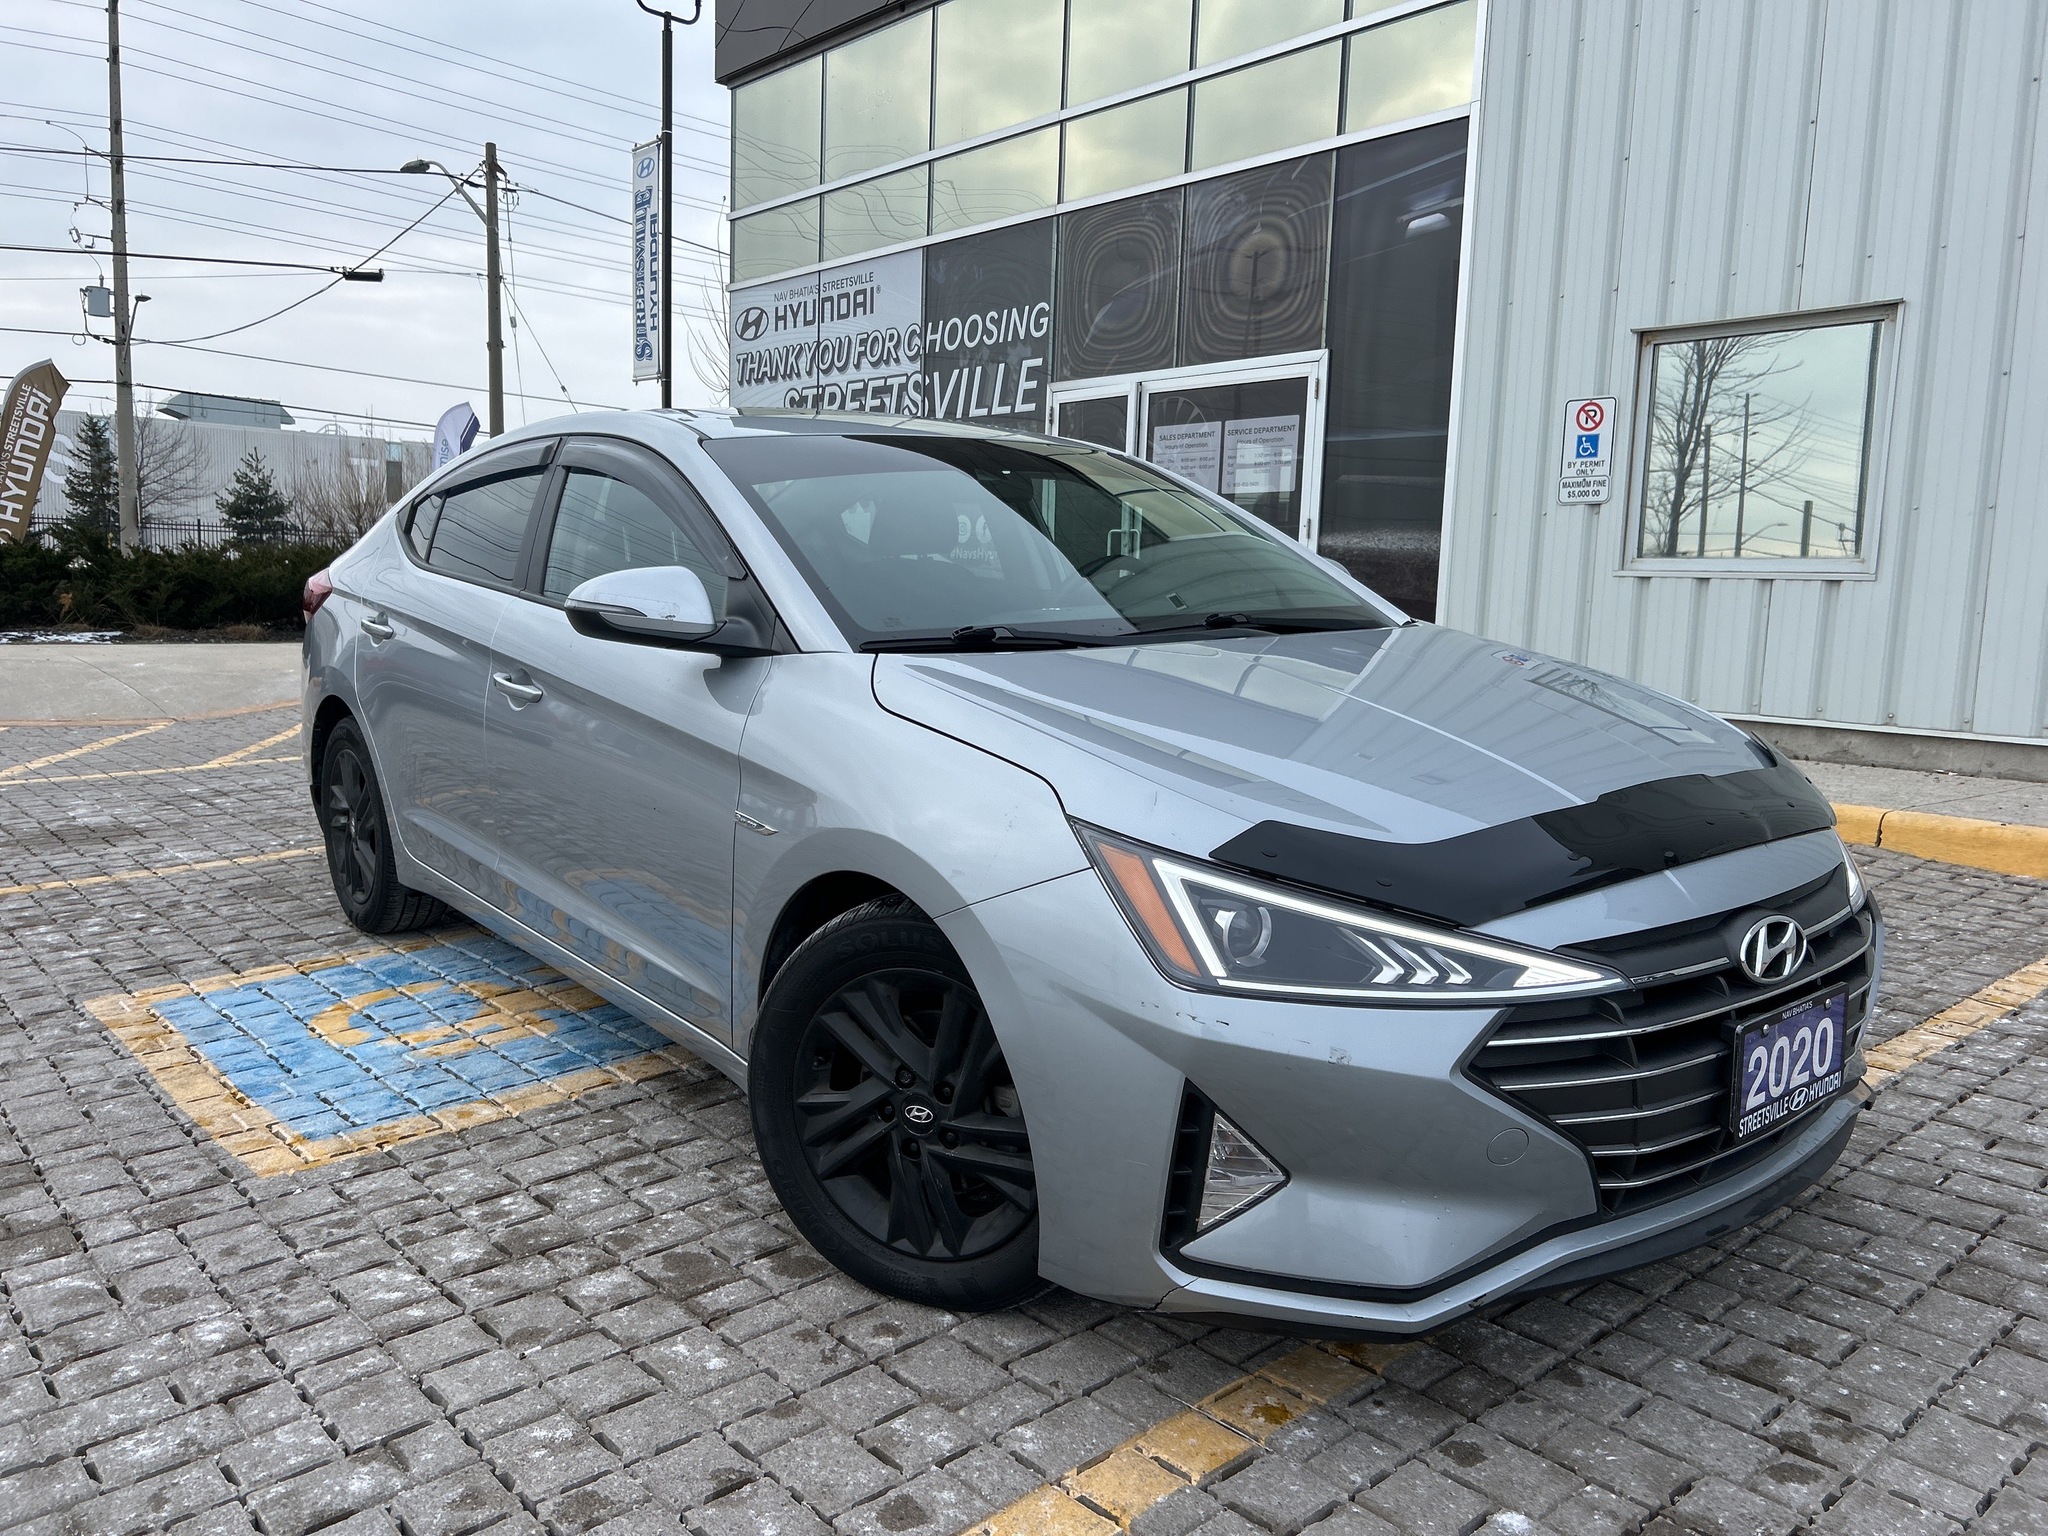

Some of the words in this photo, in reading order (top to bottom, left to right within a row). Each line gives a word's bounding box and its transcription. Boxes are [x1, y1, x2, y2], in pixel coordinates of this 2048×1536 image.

[635, 186, 653, 362] STREETSVILLE
[650, 213, 658, 331] HYUNDAI
[774, 291, 788, 302] NAV
[789, 284, 819, 300] BHATIA'S
[822, 272, 874, 293] STREETSVILLE
[736, 343, 803, 386] THANK
[804, 335, 852, 378] YOU
[853, 327, 901, 371] FOR
[903, 302, 1050, 364] CHOOSING
[8, 383, 31, 451] STREETSVILLE
[1158, 433, 1177, 441] SALES
[1177, 431, 1216, 440] DEPARTMENT
[1227, 428, 1253, 436] SERVICE
[1253, 424, 1296, 434] DEPARTMENT
[0, 387, 52, 523] HYUNDAI
[1576, 468, 1595, 476] ONLY
[1580, 460, 1605, 468] PERMIT
[1562, 480, 1591, 489] MAXIMUM
[1593, 480, 1607, 488] FINE
[1782, 1008, 1792, 1020] NAV
[1792, 1001, 1813, 1016] BHATIA'S
[1745, 1017, 1834, 1112] 2020
[1738, 1096, 1789, 1138] STREETSVILLE
[1808, 1070, 1842, 1103] HYUNDAI
